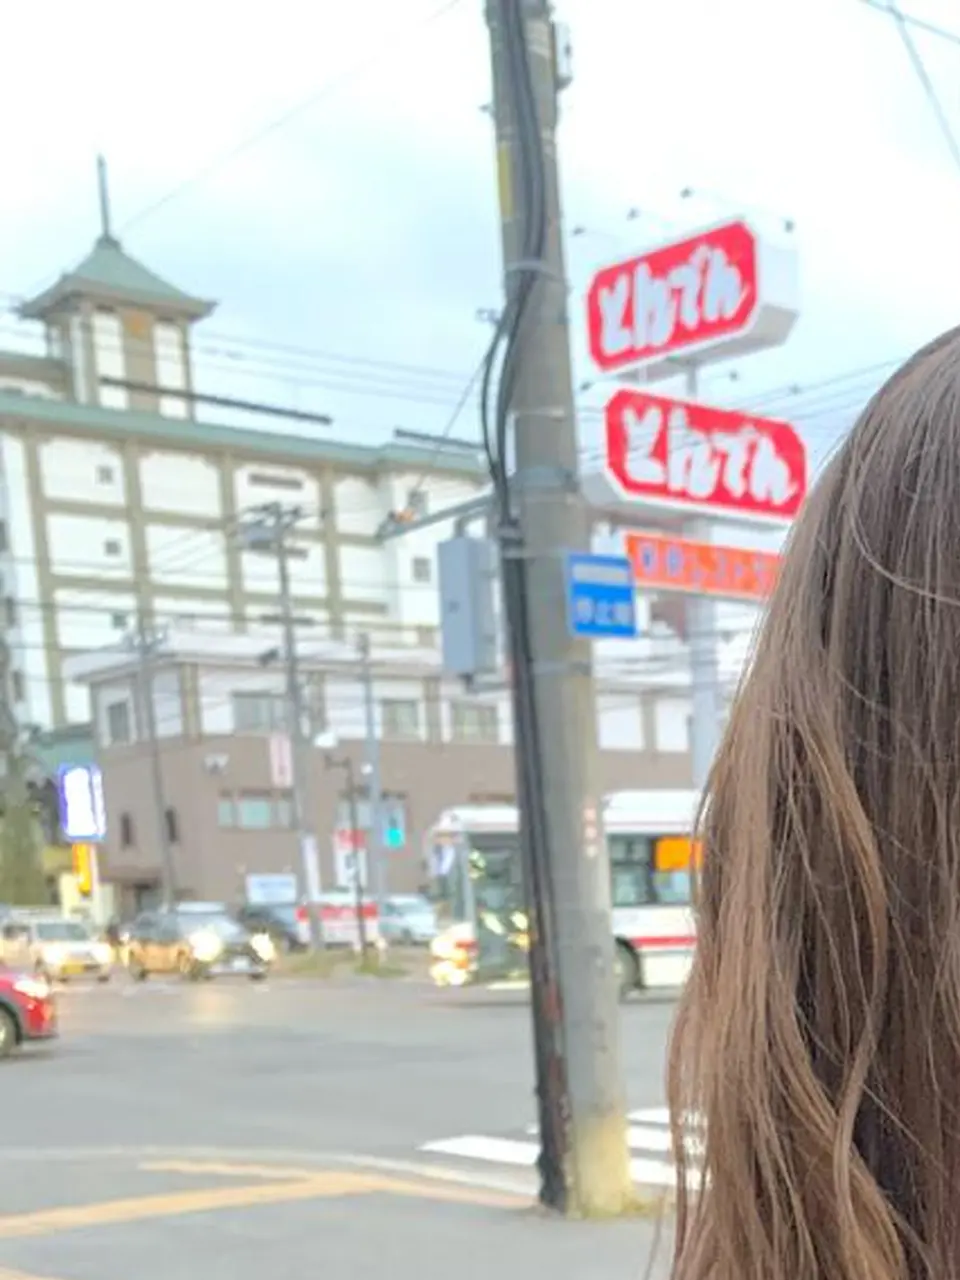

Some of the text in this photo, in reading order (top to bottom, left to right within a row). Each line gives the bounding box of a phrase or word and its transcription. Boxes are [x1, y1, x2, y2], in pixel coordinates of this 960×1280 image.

[598, 244, 749, 355] とんでん
[621, 403, 799, 505] とんでん
